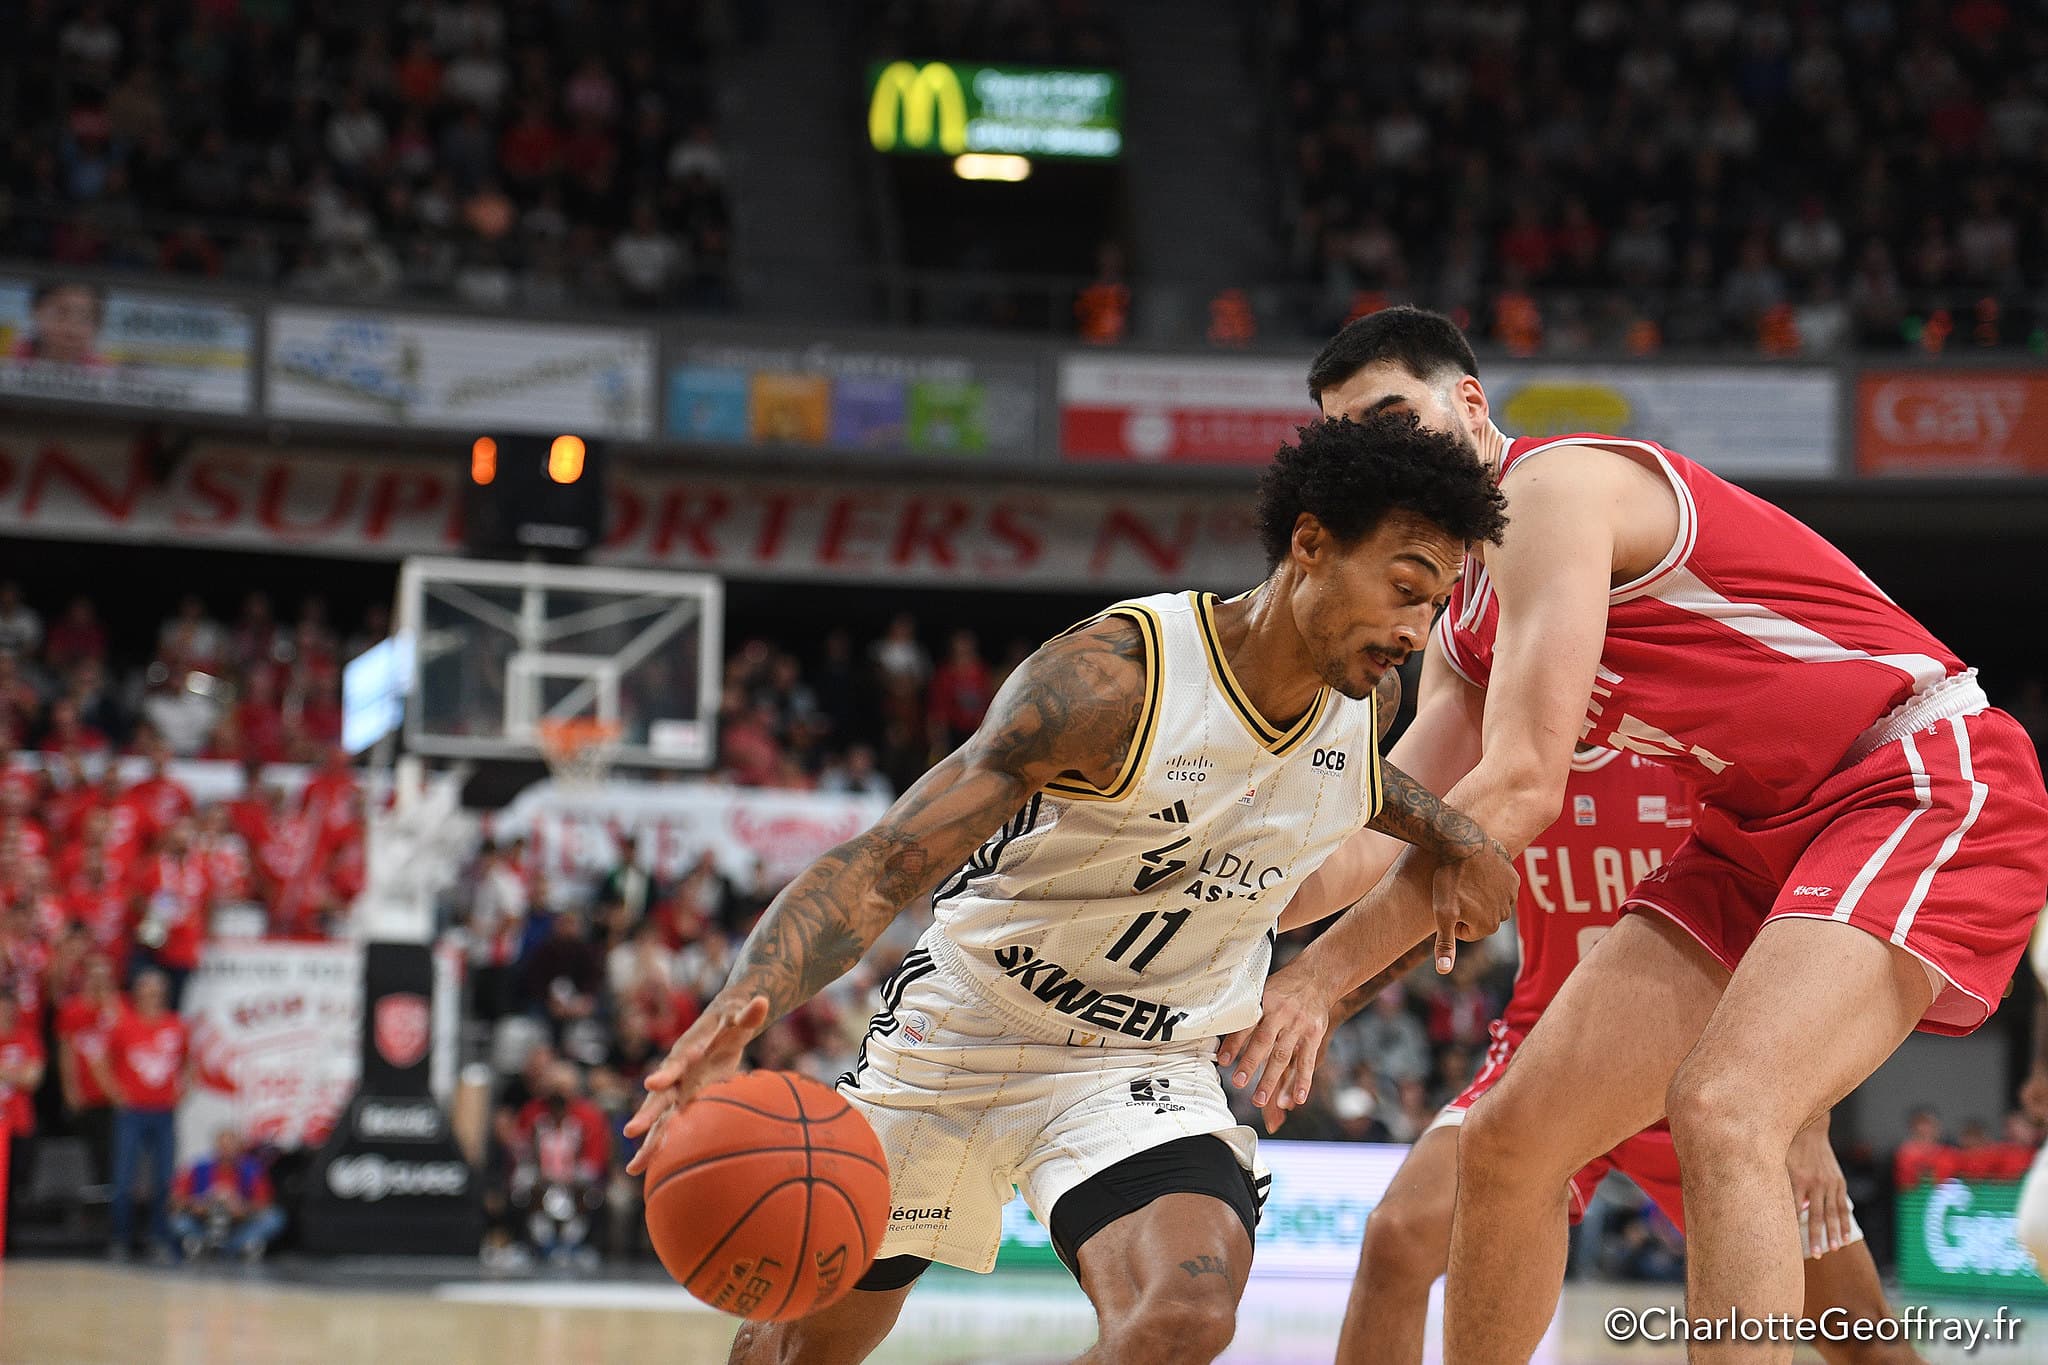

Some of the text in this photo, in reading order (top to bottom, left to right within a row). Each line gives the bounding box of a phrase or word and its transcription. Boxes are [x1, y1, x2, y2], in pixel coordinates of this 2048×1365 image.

[1312, 748, 1346, 771] DCB
[1166, 770, 1207, 782] CISCO
[1105, 907, 1193, 974] 11
[994, 945, 1190, 1042] SKWEEK
[888, 1206, 952, 1222] équat
[888, 1223, 948, 1232] Recrutement
